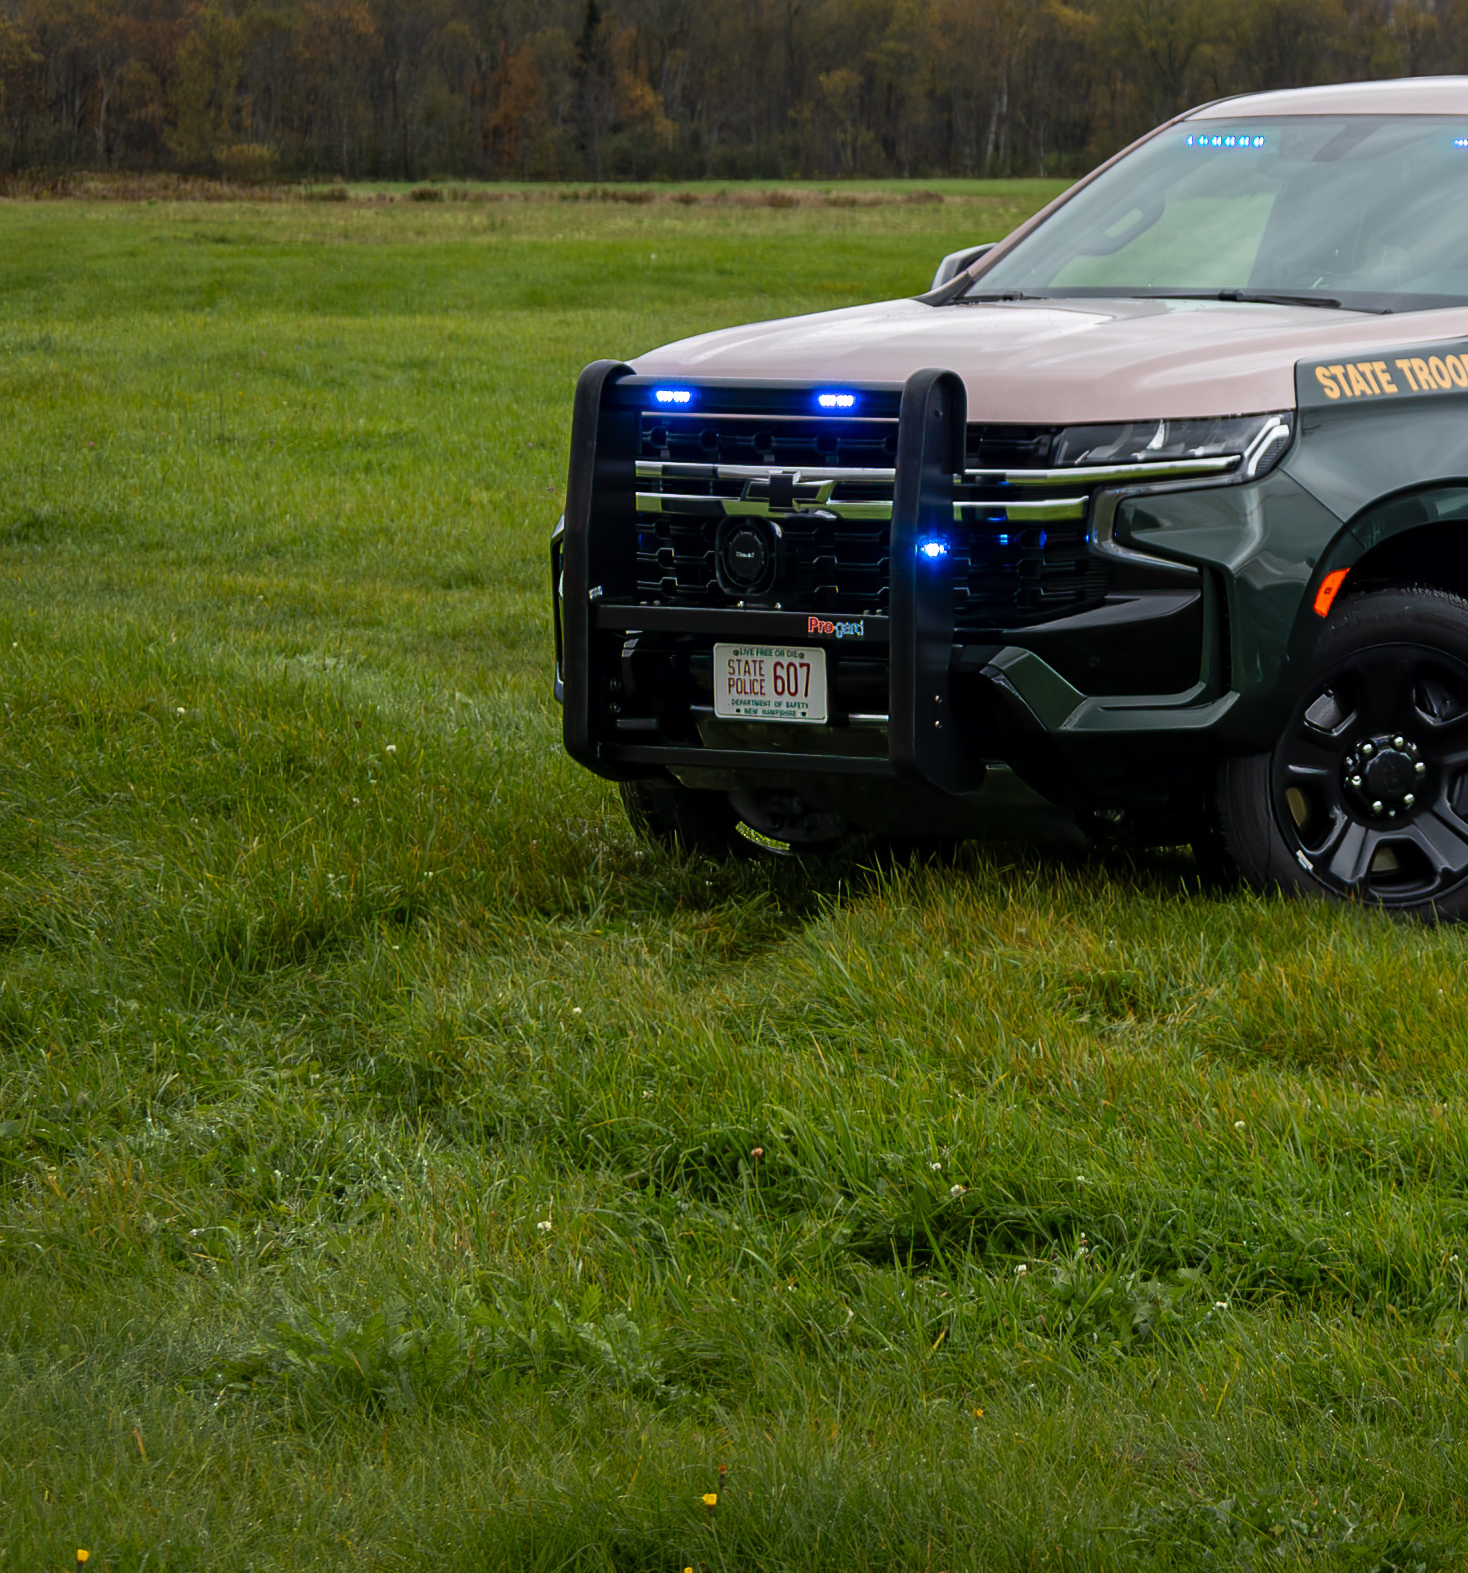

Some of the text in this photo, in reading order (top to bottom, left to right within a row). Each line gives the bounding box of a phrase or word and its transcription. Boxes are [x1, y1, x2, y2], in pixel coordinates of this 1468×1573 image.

[1315, 360, 1399, 399] STATE
[740, 647, 754, 656] LIVE
[756, 648, 773, 657] FREE
[787, 650, 798, 658] DIE
[728, 659, 811, 698] STATE 607
[728, 677, 766, 696] POLICE
[731, 698, 771, 708] DEPARTMENT
[774, 700, 782, 708] OF
